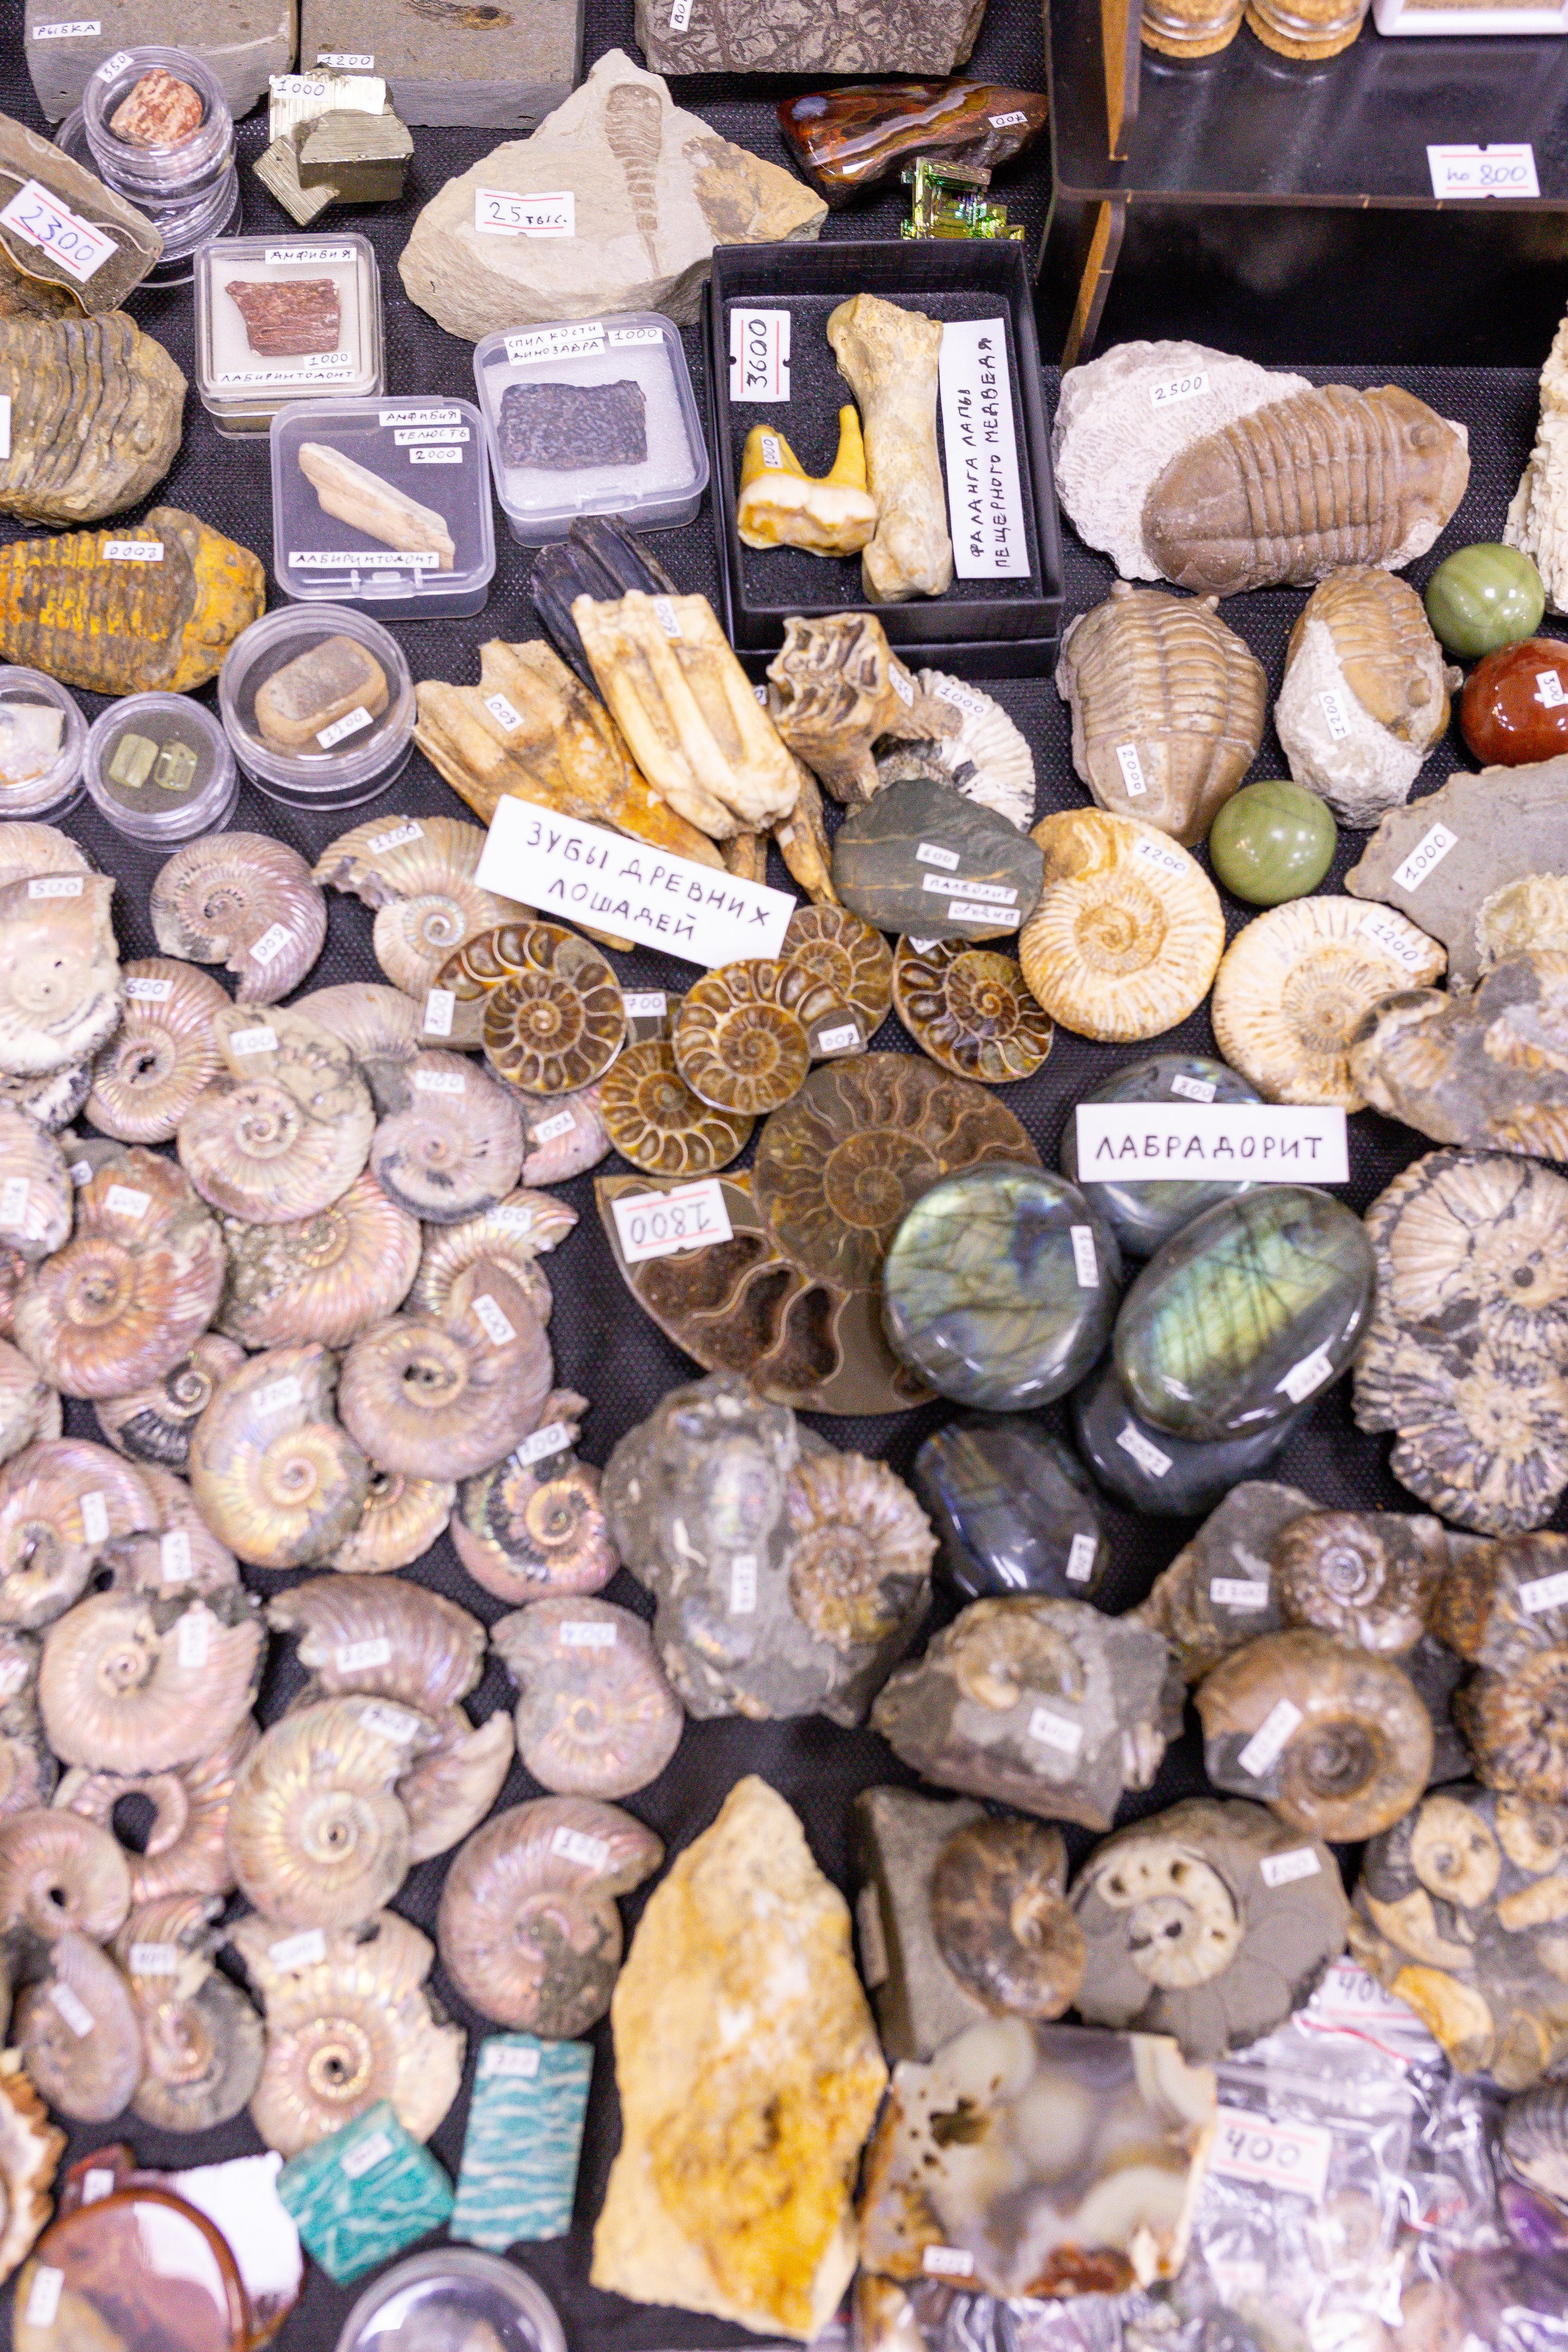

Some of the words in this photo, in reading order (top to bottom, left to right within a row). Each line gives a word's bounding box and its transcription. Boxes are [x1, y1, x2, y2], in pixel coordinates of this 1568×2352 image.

[37, 26, 97, 36] РЫБКА
[103, 55, 127, 78] 350
[322, 55, 371, 66] 1200
[277, 80, 326, 96] 1000
[1480, 164, 1527, 185] 800
[489, 202, 521, 223] 25
[18, 205, 94, 262] 2300
[270, 249, 352, 261] АМФИБИЯ
[508, 336, 544, 349] СПИЛ
[550, 326, 597, 339] КОСТИ
[614, 329, 658, 341] 1000
[308, 353, 349, 366] 1000
[511, 341, 600, 361] ДИНОЗАВРА
[747, 318, 768, 388] 3600
[978, 337, 1000, 443] МЕДВЕДЯ
[1155, 375, 1203, 401] 2500
[385, 411, 458, 422] АМФИБИЯ
[956, 389, 979, 447] ЛАПЫ
[399, 428, 467, 440] ЧЕЛЮСТЬ
[416, 448, 456, 461] 2000
[763, 439, 781, 468] 1000
[967, 457, 984, 558] ФАЛАНГА
[987, 454, 1012, 568] ПЕЩЕРНОГО
[940, 687, 985, 713] 1000
[1543, 676, 1564, 703] 300
[1323, 695, 1347, 735] 1200
[326, 714, 363, 743] 1200
[1121, 749, 1142, 791] 2000
[1140, 844, 1187, 871] 1200
[1405, 833, 1449, 881] 1000
[527, 822, 608, 870] ЗУБЫ
[619, 859, 771, 926] ДРЕВНИХ
[35, 881, 78, 895] 500
[549, 878, 696, 941] ЛОШАДЕЙ
[1372, 922, 1419, 962] 1200
[1096, 1136, 1323, 1160] ЛАБРАДОРИТ
[630, 1202, 710, 1245] 1800
[1226, 2128, 1302, 2168] 400
